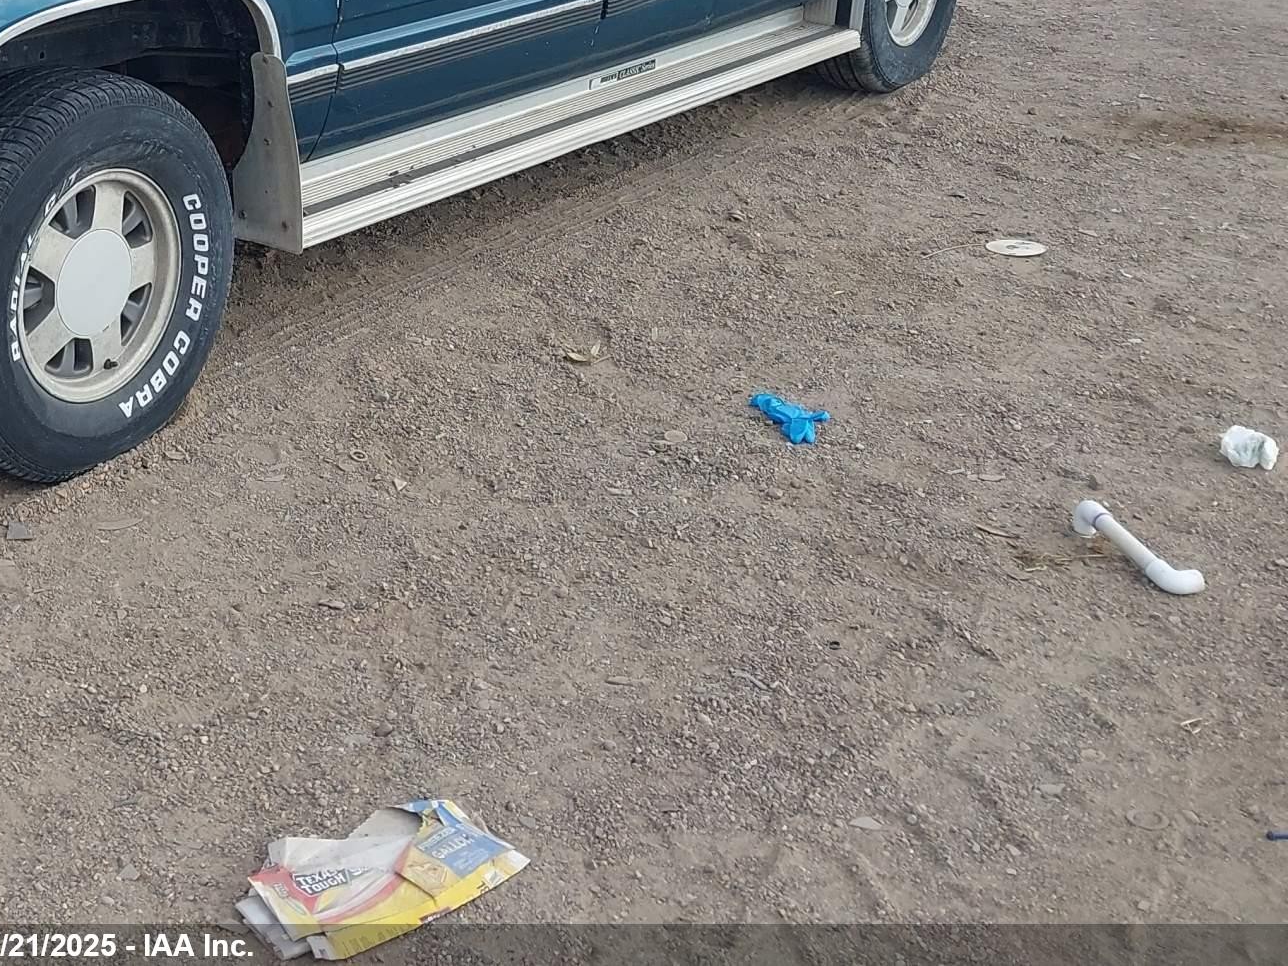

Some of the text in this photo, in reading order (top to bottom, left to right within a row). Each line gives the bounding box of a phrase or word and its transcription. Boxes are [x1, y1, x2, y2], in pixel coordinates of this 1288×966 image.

[118, 192, 210, 419] COOPER COBRA
[300, 872, 346, 895] TOUGH
